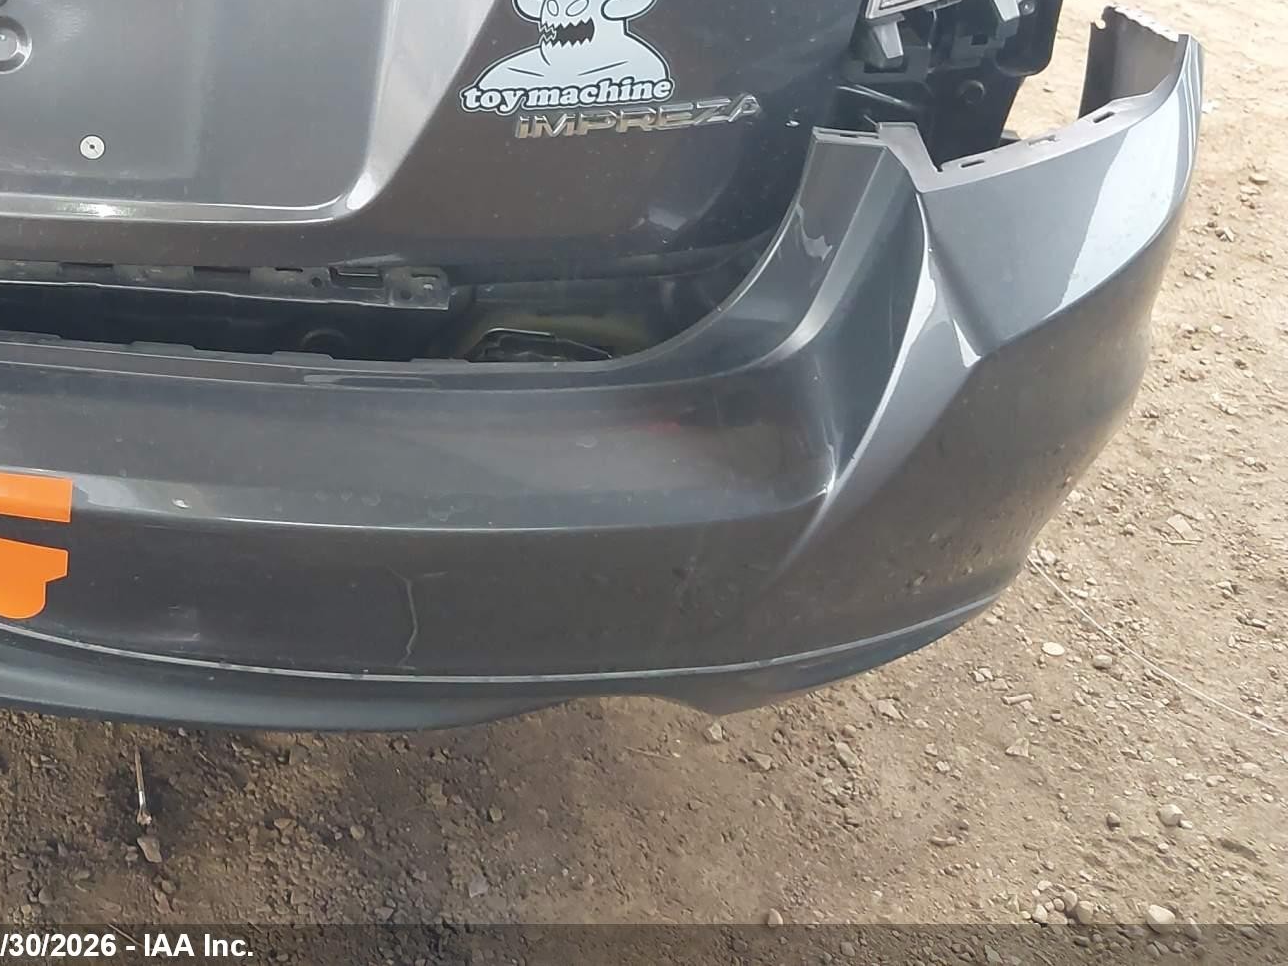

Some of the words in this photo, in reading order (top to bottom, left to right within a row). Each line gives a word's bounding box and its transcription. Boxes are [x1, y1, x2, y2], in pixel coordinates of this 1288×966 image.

[464, 84, 525, 113] toy
[527, 80, 673, 108] machine
[516, 93, 761, 138] IMPREZA
